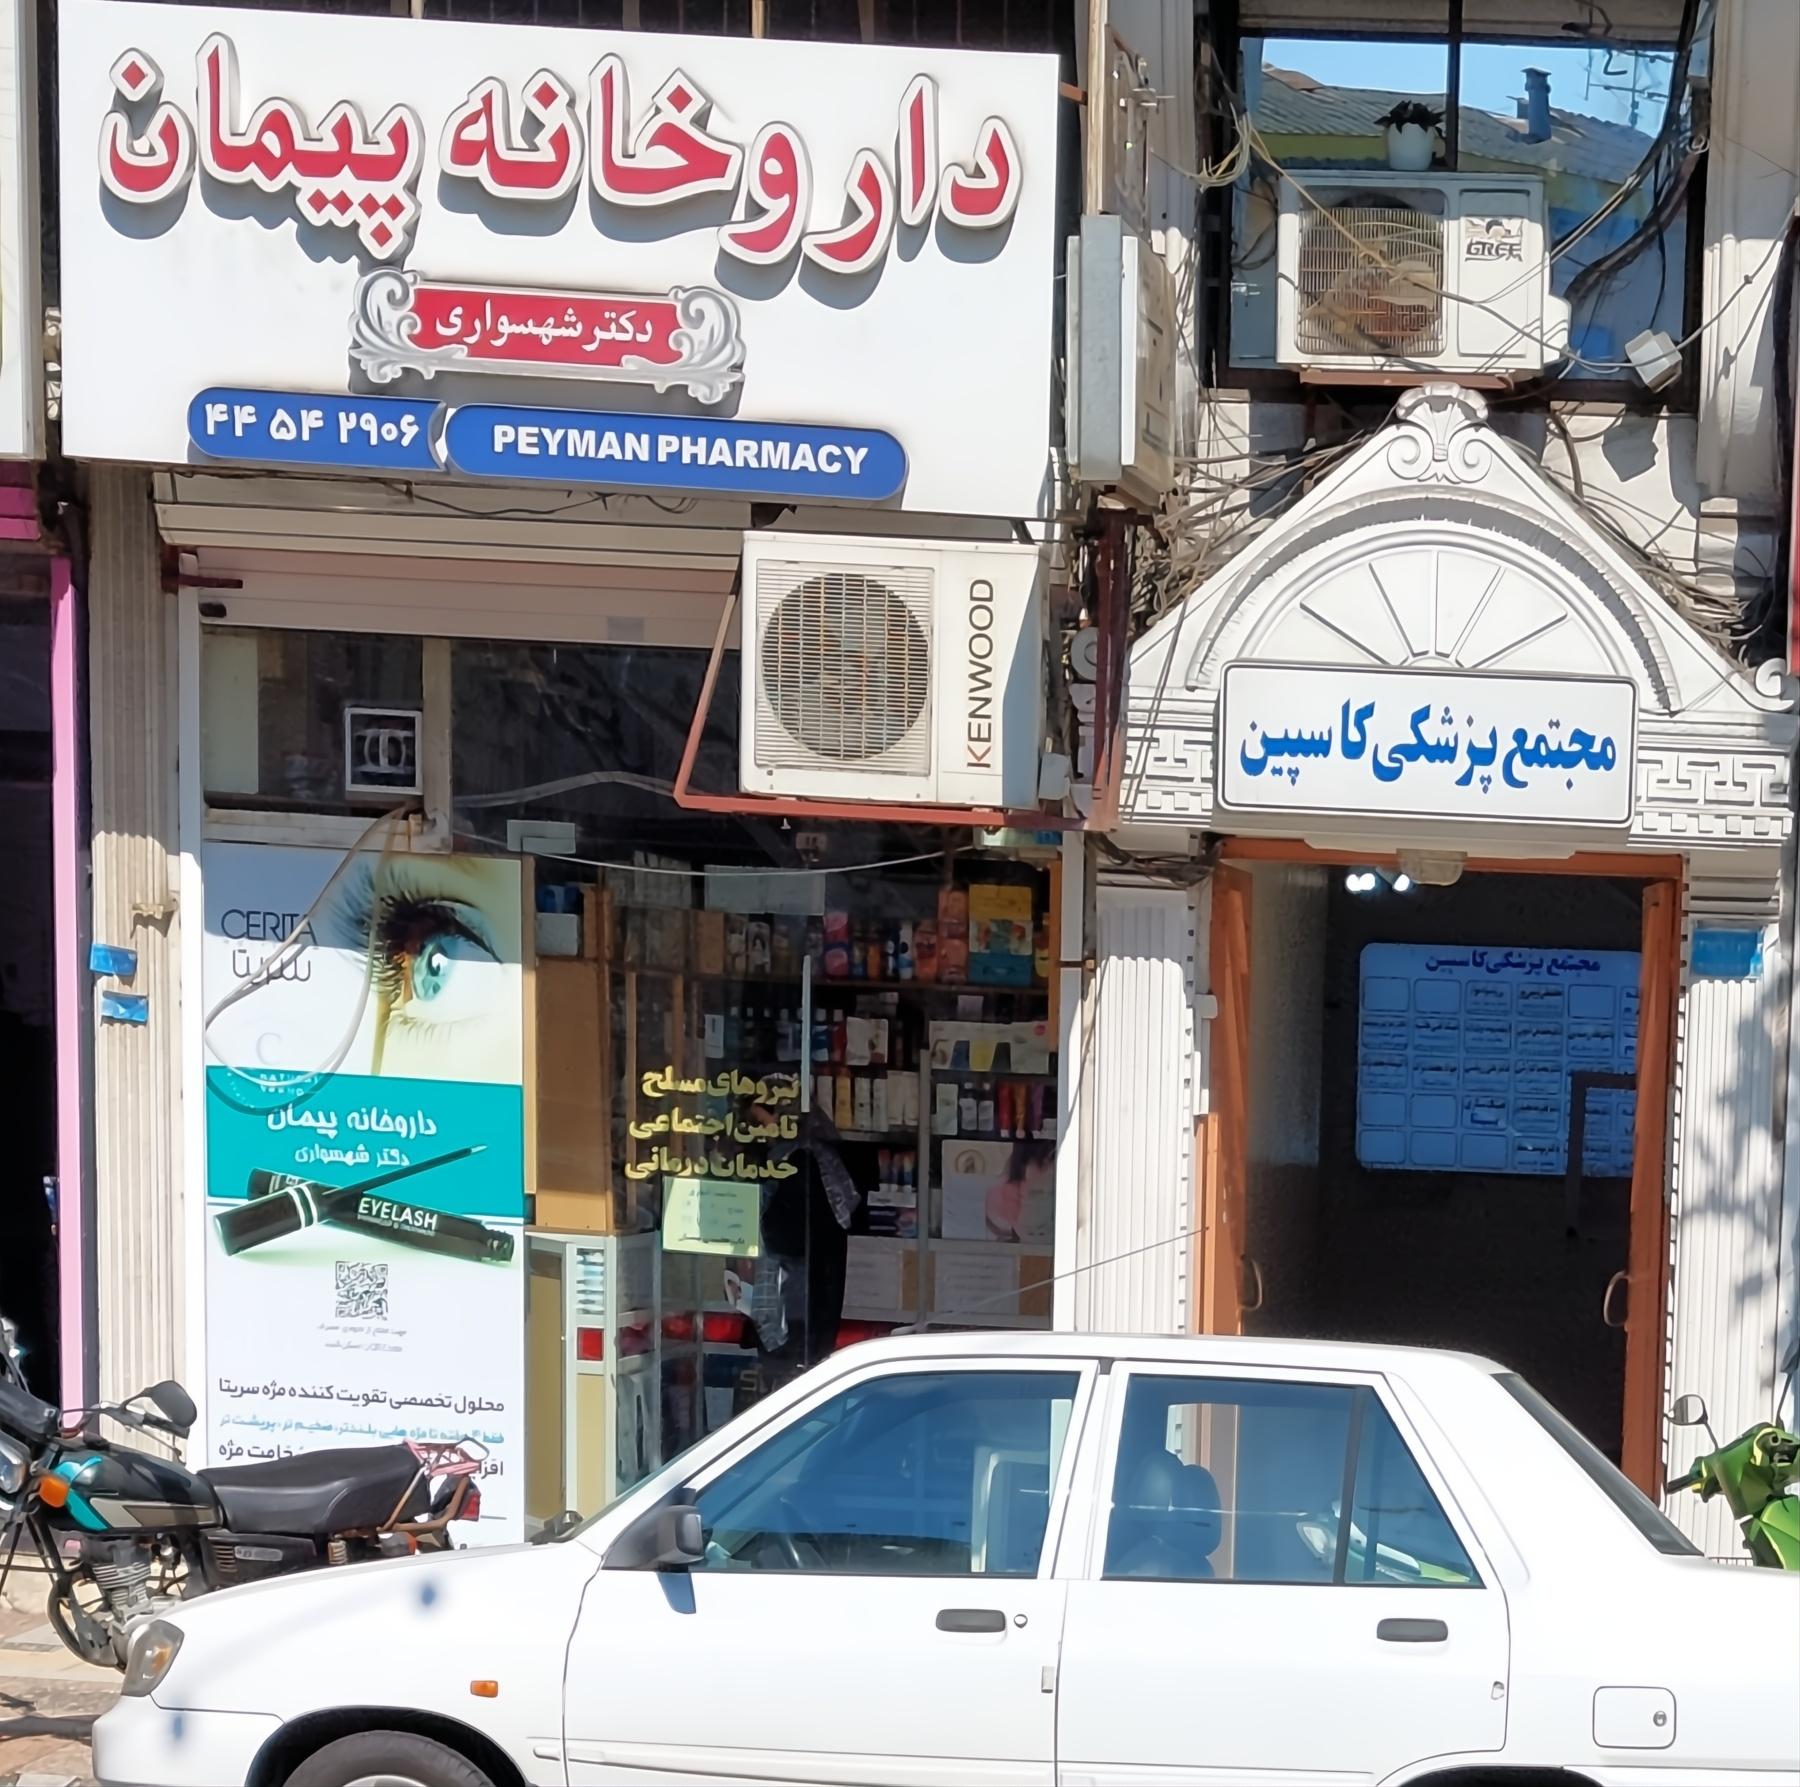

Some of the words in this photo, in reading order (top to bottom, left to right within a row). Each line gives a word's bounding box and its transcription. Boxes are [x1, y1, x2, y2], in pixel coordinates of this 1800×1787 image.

[101, 33, 424, 258] پیمان
[440, 54, 1020, 272] داروخانه
[435, 299, 583, 346] شهسواری
[581, 311, 653, 351] دکتر
[493, 424, 650, 463] PEYMAN
[657, 434, 868, 475] PHARMACY
[966, 578, 994, 769] KENWOOD
[1239, 697, 1377, 787] کاسپین
[1371, 703, 1499, 795] پزشکی
[1501, 717, 1617, 791] مجتمع
[221, 908, 319, 946] CERITA
[641, 1064, 706, 1097] مسلح
[706, 1068, 799, 1105] نیروهای
[266, 1103, 338, 1139] پیمان
[346, 1106, 438, 1140] داروخانه
[628, 1106, 734, 1140] اجتماعی
[294, 1143, 370, 1165] شهسواری
[375, 1148, 411, 1168] دکتر
[624, 1145, 711, 1180] درمانی
[711, 1152, 799, 1180] خدمات
[358, 1197, 438, 1231] EYELASH
[218, 1377, 260, 1398] سریتا
[261, 1379, 287, 1400] مژه
[288, 1384, 334, 1401] کننده
[336, 1388, 387, 1407] تقویت
[388, 1395, 452, 1410] تخصصی
[454, 1395, 505, 1415] محلول
[218, 1439, 245, 1460] مژه
